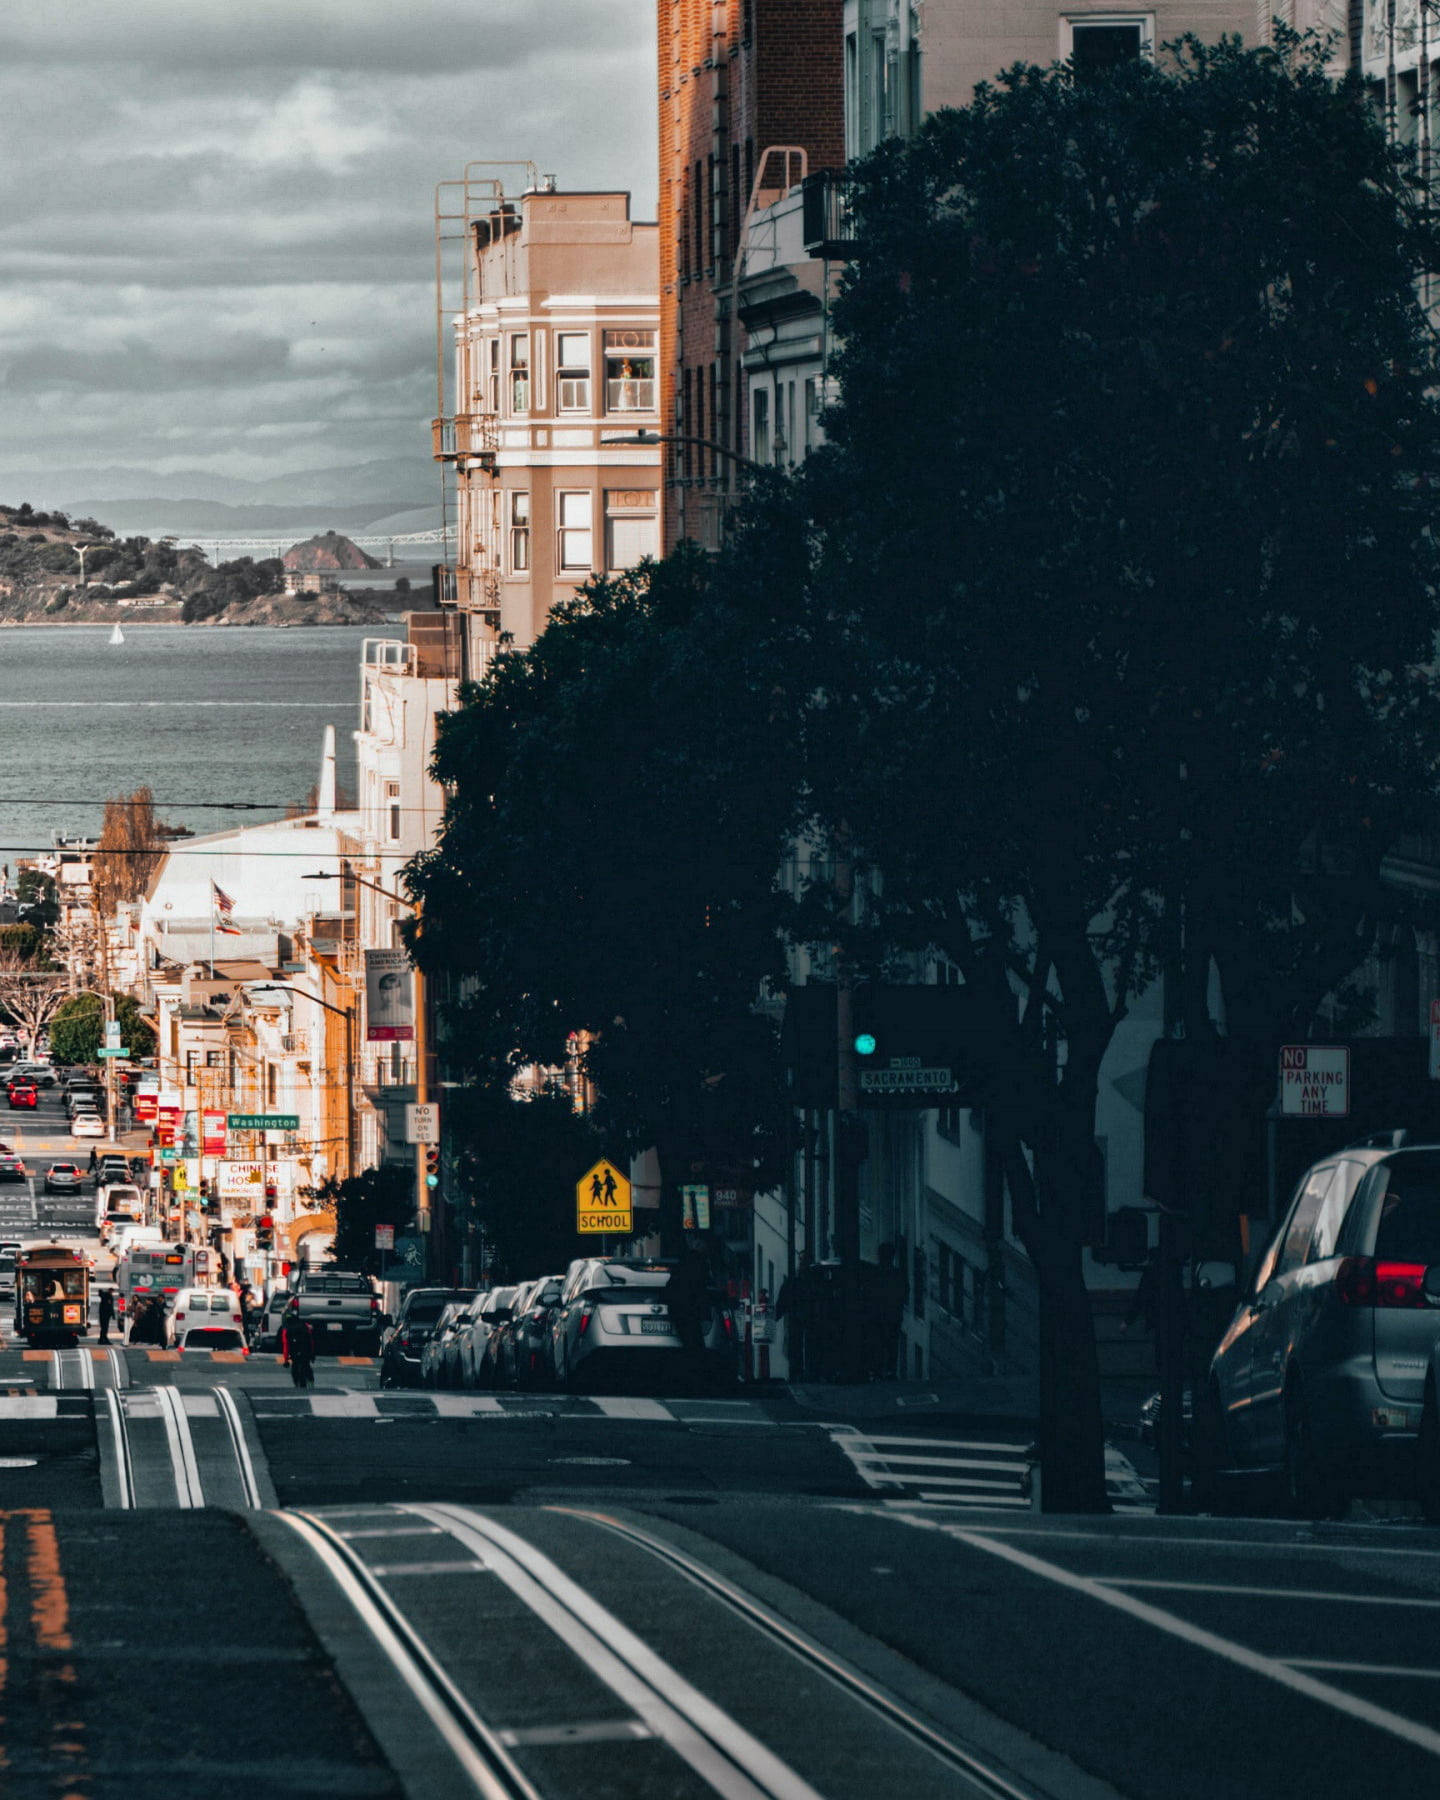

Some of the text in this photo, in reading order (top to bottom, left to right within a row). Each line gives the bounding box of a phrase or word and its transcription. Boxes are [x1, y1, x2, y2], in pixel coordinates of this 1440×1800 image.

[1283, 1049, 1305, 1067] NO
[864, 1070, 947, 1085] SACRAMENTO
[1286, 1071, 1343, 1085] PARKING
[1302, 1086, 1328, 1099] ANY
[415, 1106, 430, 1115] NO
[1300, 1100, 1329, 1114] TIME
[231, 1118, 296, 1128] Washington
[230, 1164, 279, 1173] CHINESE
[227, 1176, 280, 1185] HOSAL
[581, 1215, 628, 1228] SCHOOL
